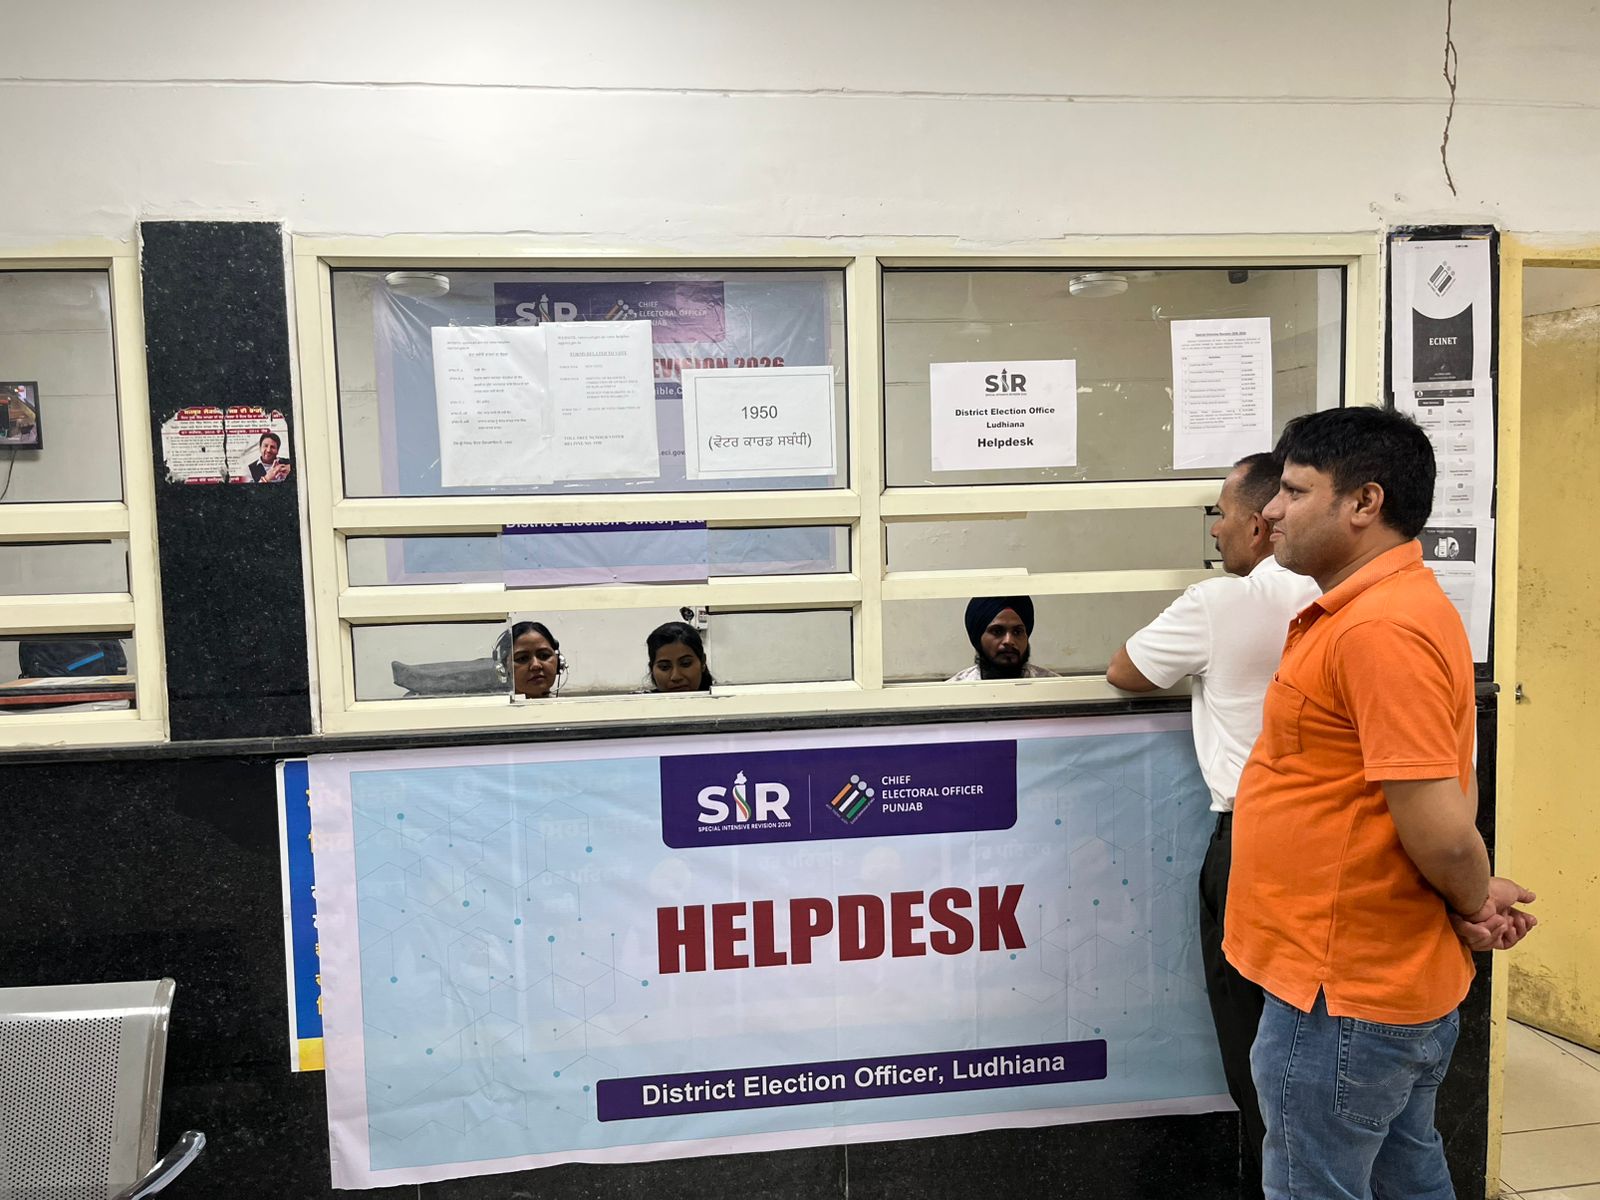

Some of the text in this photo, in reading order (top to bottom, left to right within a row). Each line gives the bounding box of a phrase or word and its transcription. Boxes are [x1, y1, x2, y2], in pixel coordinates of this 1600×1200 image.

[1428, 336, 1458, 346] ECINET
[985, 368, 1026, 393] SIR
[741, 405, 778, 420] 1950
[742, 436, 774, 447] ਕਾਰਡ
[977, 437, 1034, 449] Helpdesk
[881, 775, 911, 785] CHIEF
[697, 770, 791, 824] SIR
[882, 785, 984, 799] ELECTORAL OFFICER
[882, 802, 923, 813] PUNJAB
[721, 823, 750, 831] INTENSIVE
[656, 884, 1027, 975] HELPDESK
[642, 1055, 1065, 1105] District Election Officer, Ludhiana
